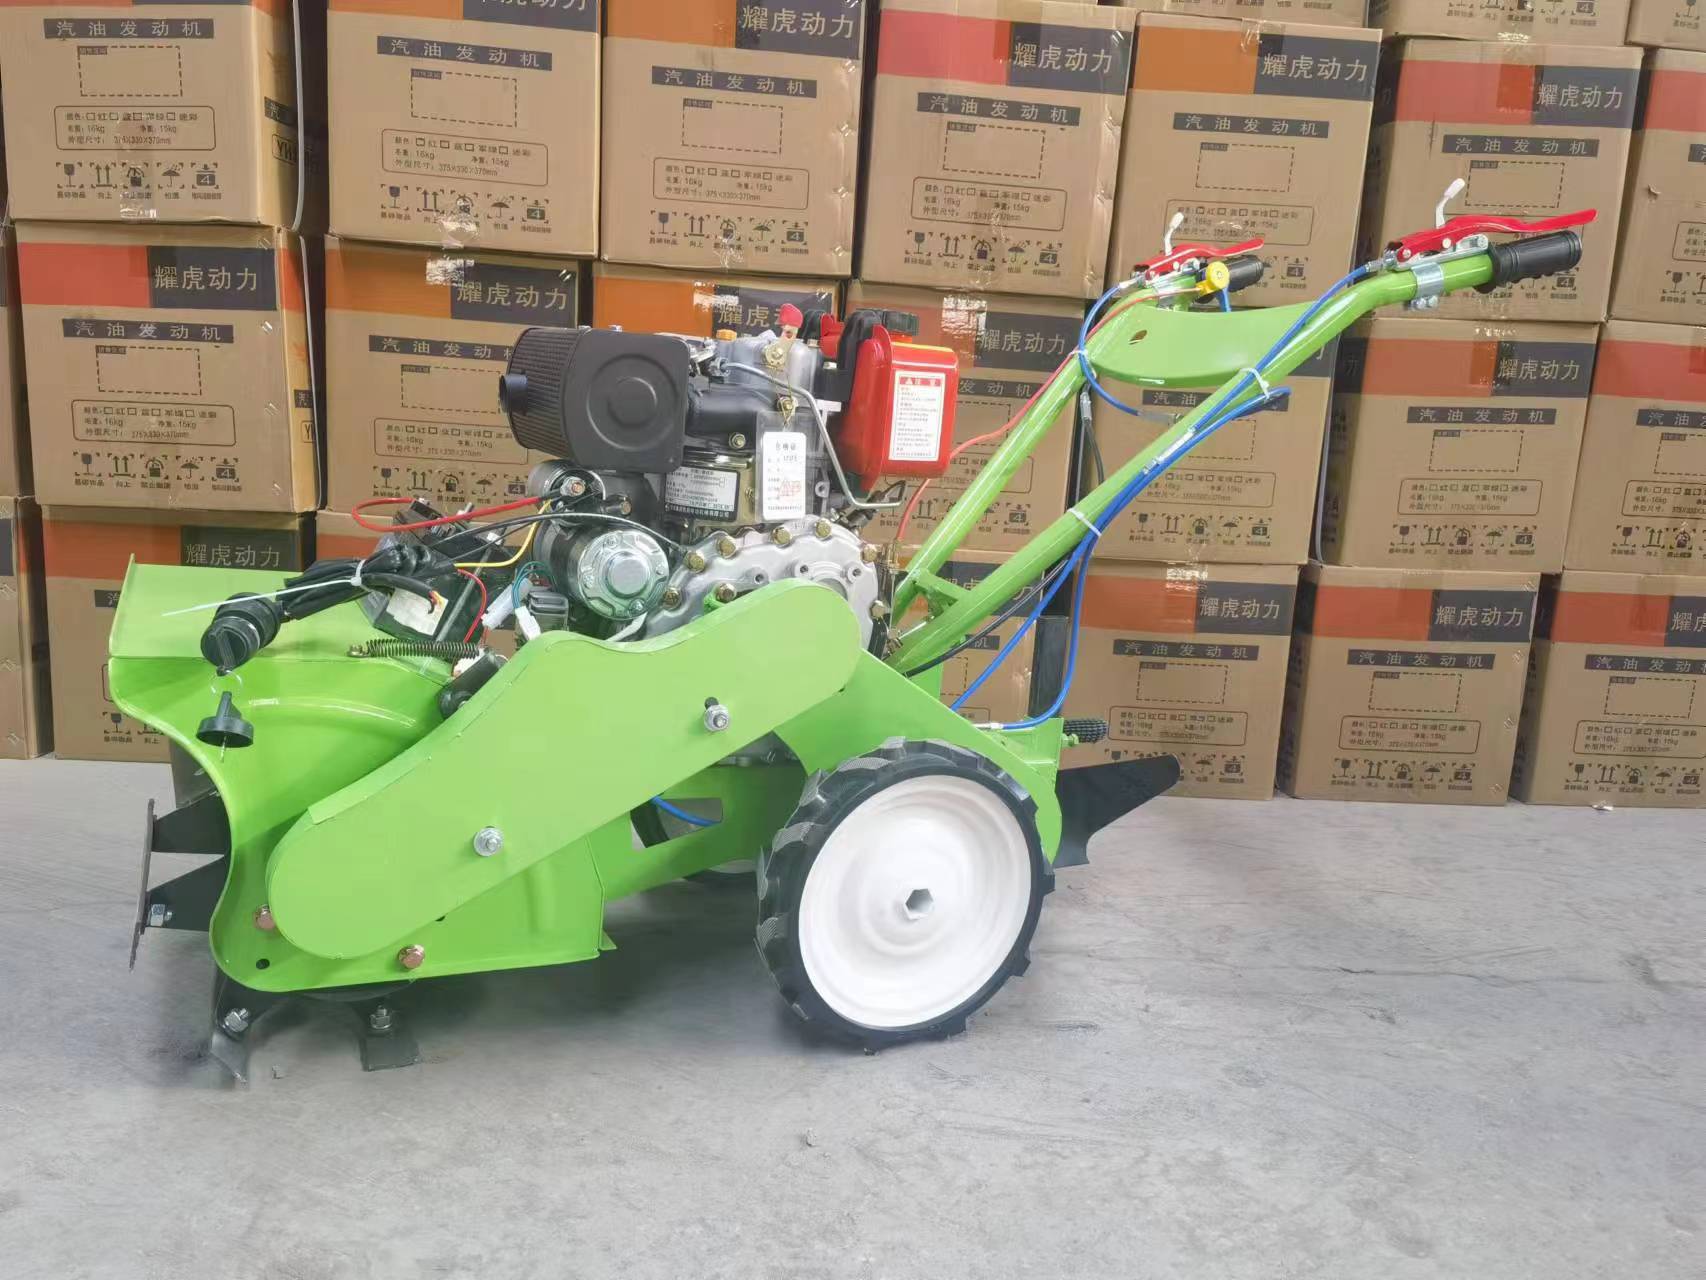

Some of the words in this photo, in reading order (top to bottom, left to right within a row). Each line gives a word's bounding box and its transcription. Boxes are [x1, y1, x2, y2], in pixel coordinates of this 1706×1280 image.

[57, 21, 201, 36] 汽油发动机
[743, 6, 854, 38] 耀虎动力
[391, 39, 540, 67] 汽油发动机
[1013, 42, 1112, 74] 耀虎动力
[1261, 53, 1367, 81] 耀虎动力
[665, 70, 804, 95] 汽油发动机
[1536, 84, 1623, 108] 耀虎动力
[930, 95, 1068, 123] 汽油发动机
[1185, 114, 1318, 136] 汽油发动机
[1456, 138, 1587, 154] 汽油发动机
[155, 265, 257, 291] 耀虎动力
[457, 280, 567, 310] 耀虎动力
[718, 304, 780, 326] 耀虎
[75, 322, 220, 340] 汽油发动机
[981, 330, 1064, 355] 耀虎动力
[1498, 359, 1580, 380] 耀虎动力
[1419, 409, 1544, 422] 汽油发动机
[186, 544, 279, 568] 耀虎动力
[1201, 597, 1280, 618] 耀虎动力
[1435, 606, 1523, 626] 耀虎动力
[1125, 642, 1248, 658] 汽油发动机
[1359, 652, 1483, 667] 汽油发动机
